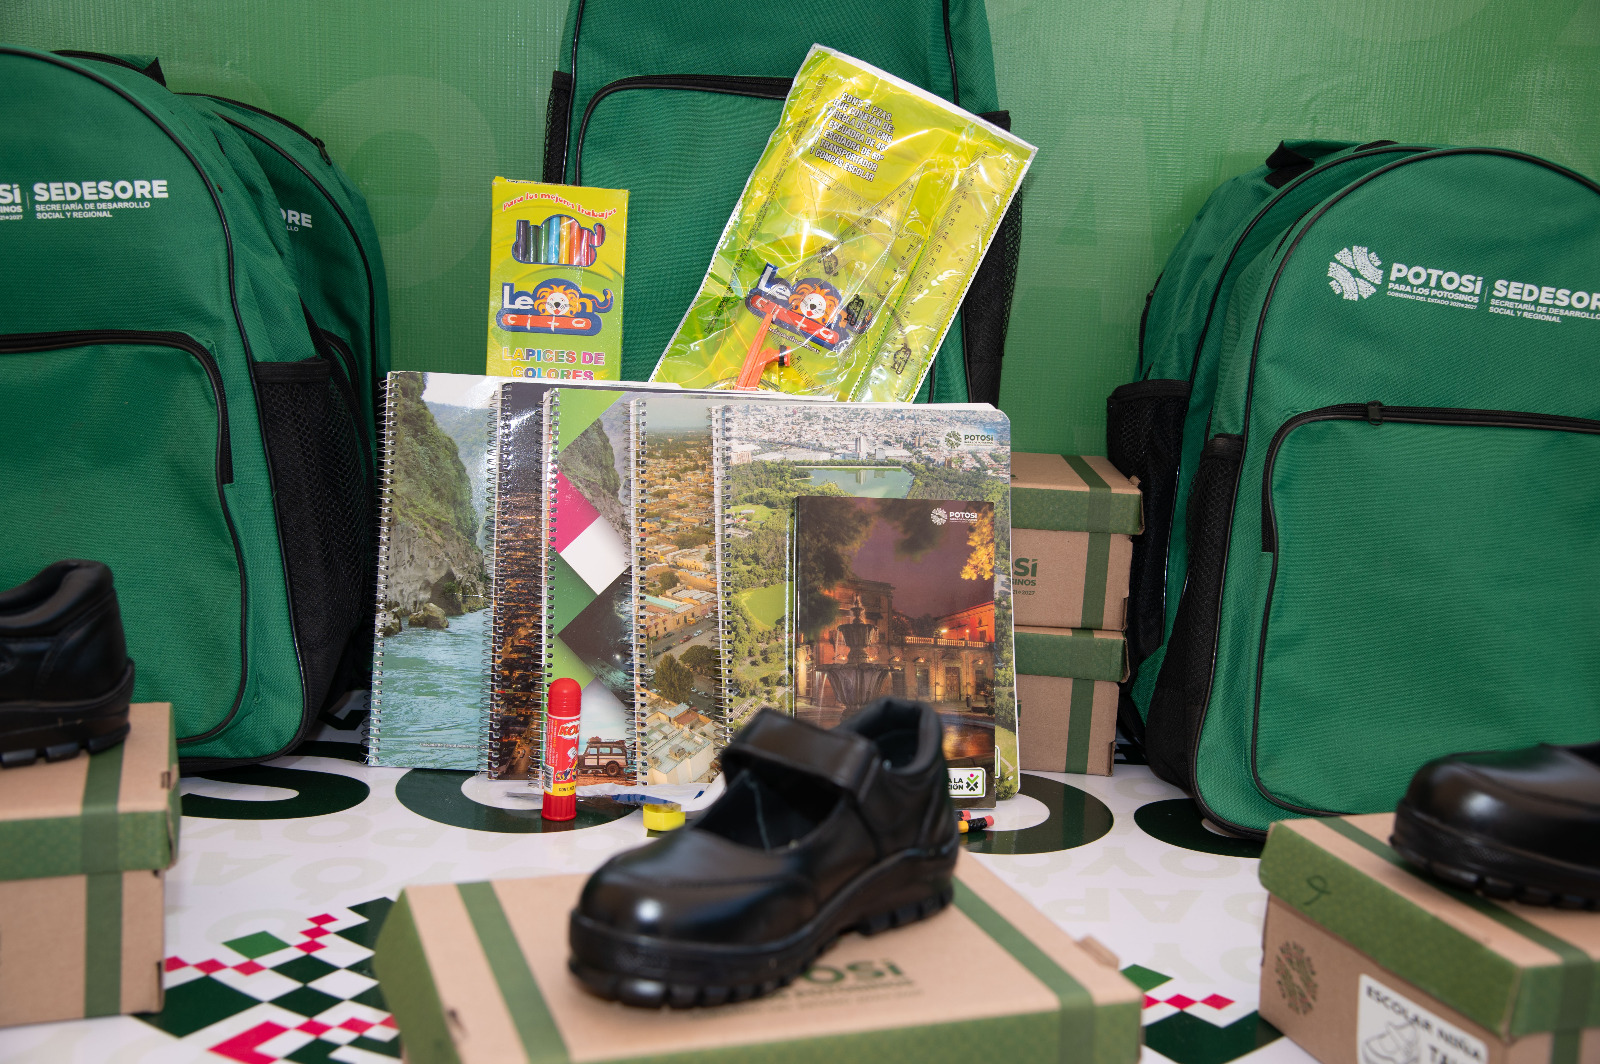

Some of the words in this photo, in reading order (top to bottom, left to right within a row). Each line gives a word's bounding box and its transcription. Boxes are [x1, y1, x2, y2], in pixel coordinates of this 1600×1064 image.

[832, 110, 856, 126] REGLA
[855, 120, 867, 131] DE
[866, 125, 875, 135] 30
[848, 106, 882, 126] CONSTAN
[823, 129, 861, 152] ESCUADRA
[860, 146, 871, 156] DE
[828, 119, 865, 142] ESCUADRA
[865, 136, 875, 147] DE
[814, 147, 844, 167] COMPÁS
[842, 161, 874, 182] ESCOLAR
[819, 139, 878, 172] TRANSPORTADOR
[33, 180, 168, 202] SEDESORE
[36, 202, 83, 211] SECRETARÍA
[97, 202, 150, 210] DESARROLLO
[1388, 283, 1411, 292] PARA
[1413, 287, 1430, 295] LOS
[1431, 290, 1479, 303] POTOSINOS
[1492, 280, 1600, 310] SEDESOR
[1489, 306, 1515, 316] SOCIAL
[1523, 312, 1561, 322] REGIONAL
[1490, 298, 1535, 311] SECRETARÍA
[1549, 307, 1600, 319] DESARROLLO
[502, 347, 576, 364] LAPICES
[581, 351, 605, 365] DE
[512, 366, 594, 380] COLORES
[1366, 985, 1432, 1030] ESCOLAR
